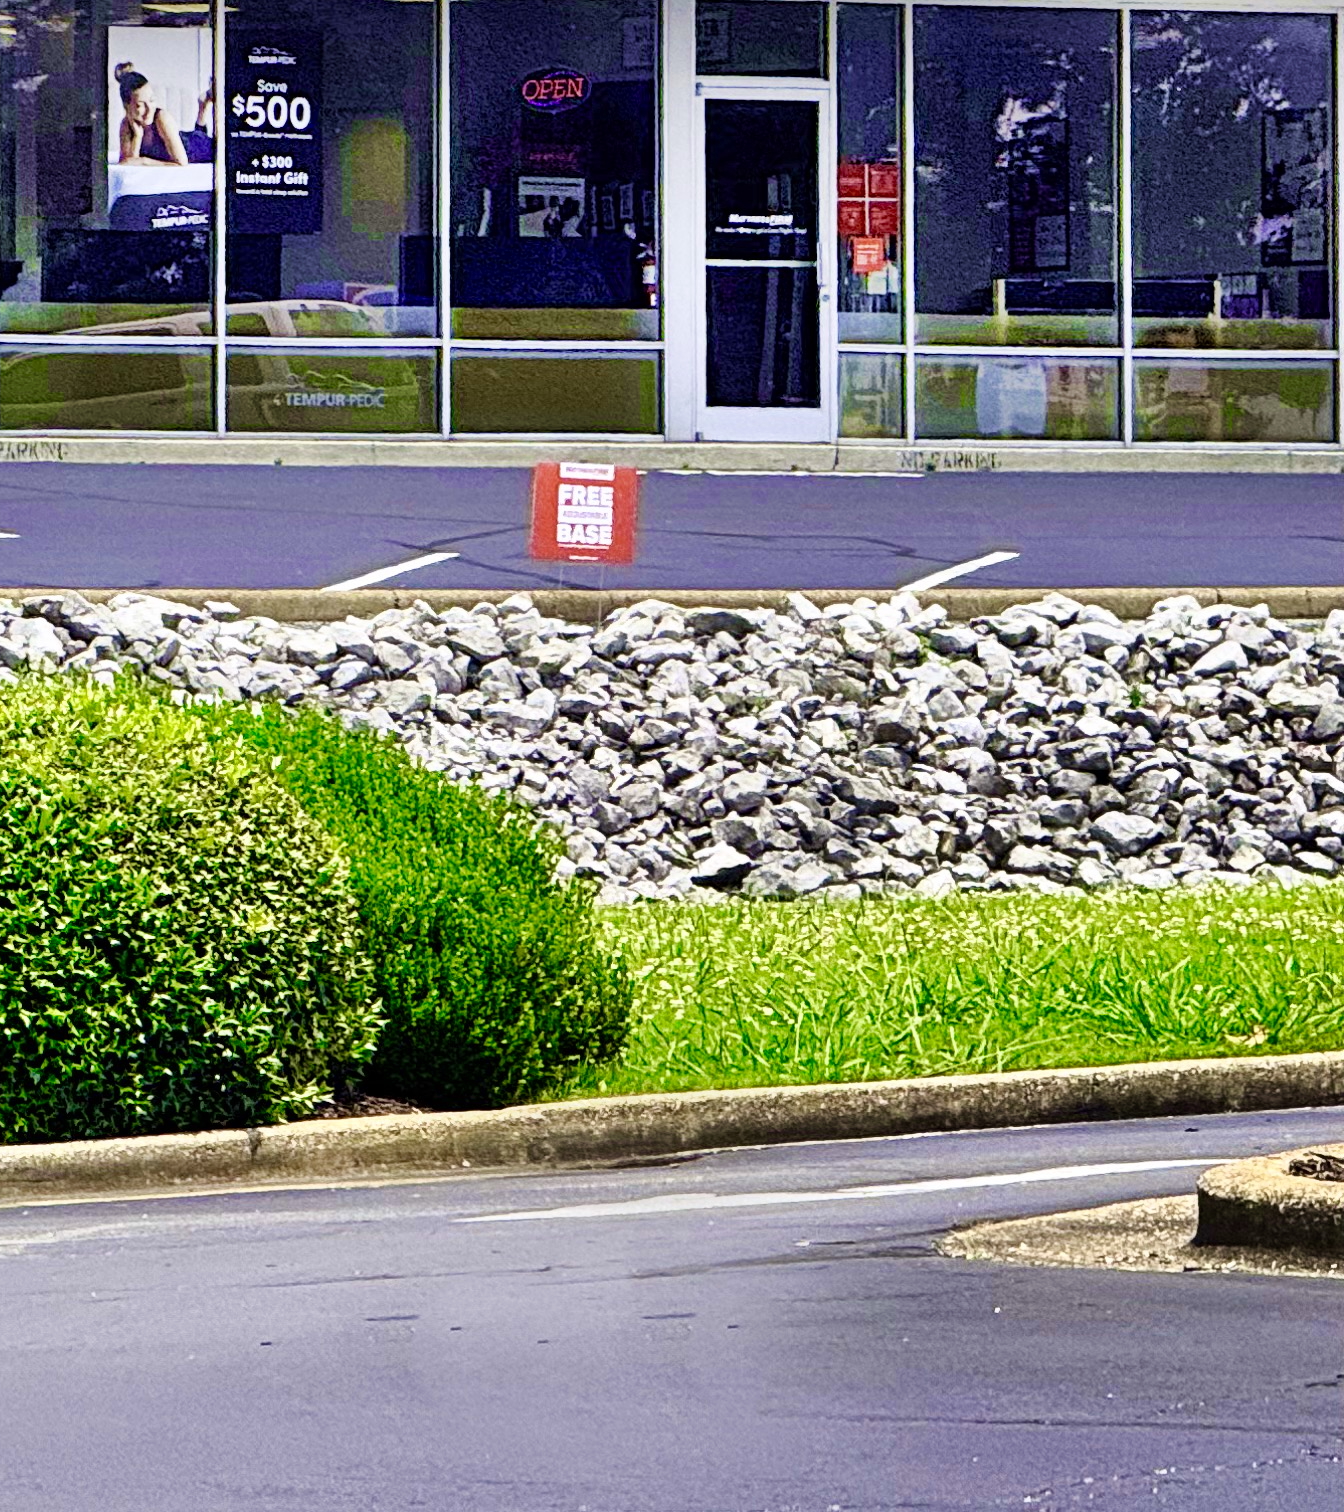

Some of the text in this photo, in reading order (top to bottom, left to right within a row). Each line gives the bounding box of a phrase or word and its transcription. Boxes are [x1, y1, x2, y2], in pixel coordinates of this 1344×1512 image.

[257, 79, 288, 94] Save
[522, 77, 585, 101] OPEN
[232, 93, 312, 130] $500
[261, 154, 293, 169] $300
[236, 170, 309, 186] Instant Gift
[287, 392, 388, 408] TEMPUR-PEDIC
[558, 483, 614, 506] FREE
[556, 523, 613, 546] BASE
